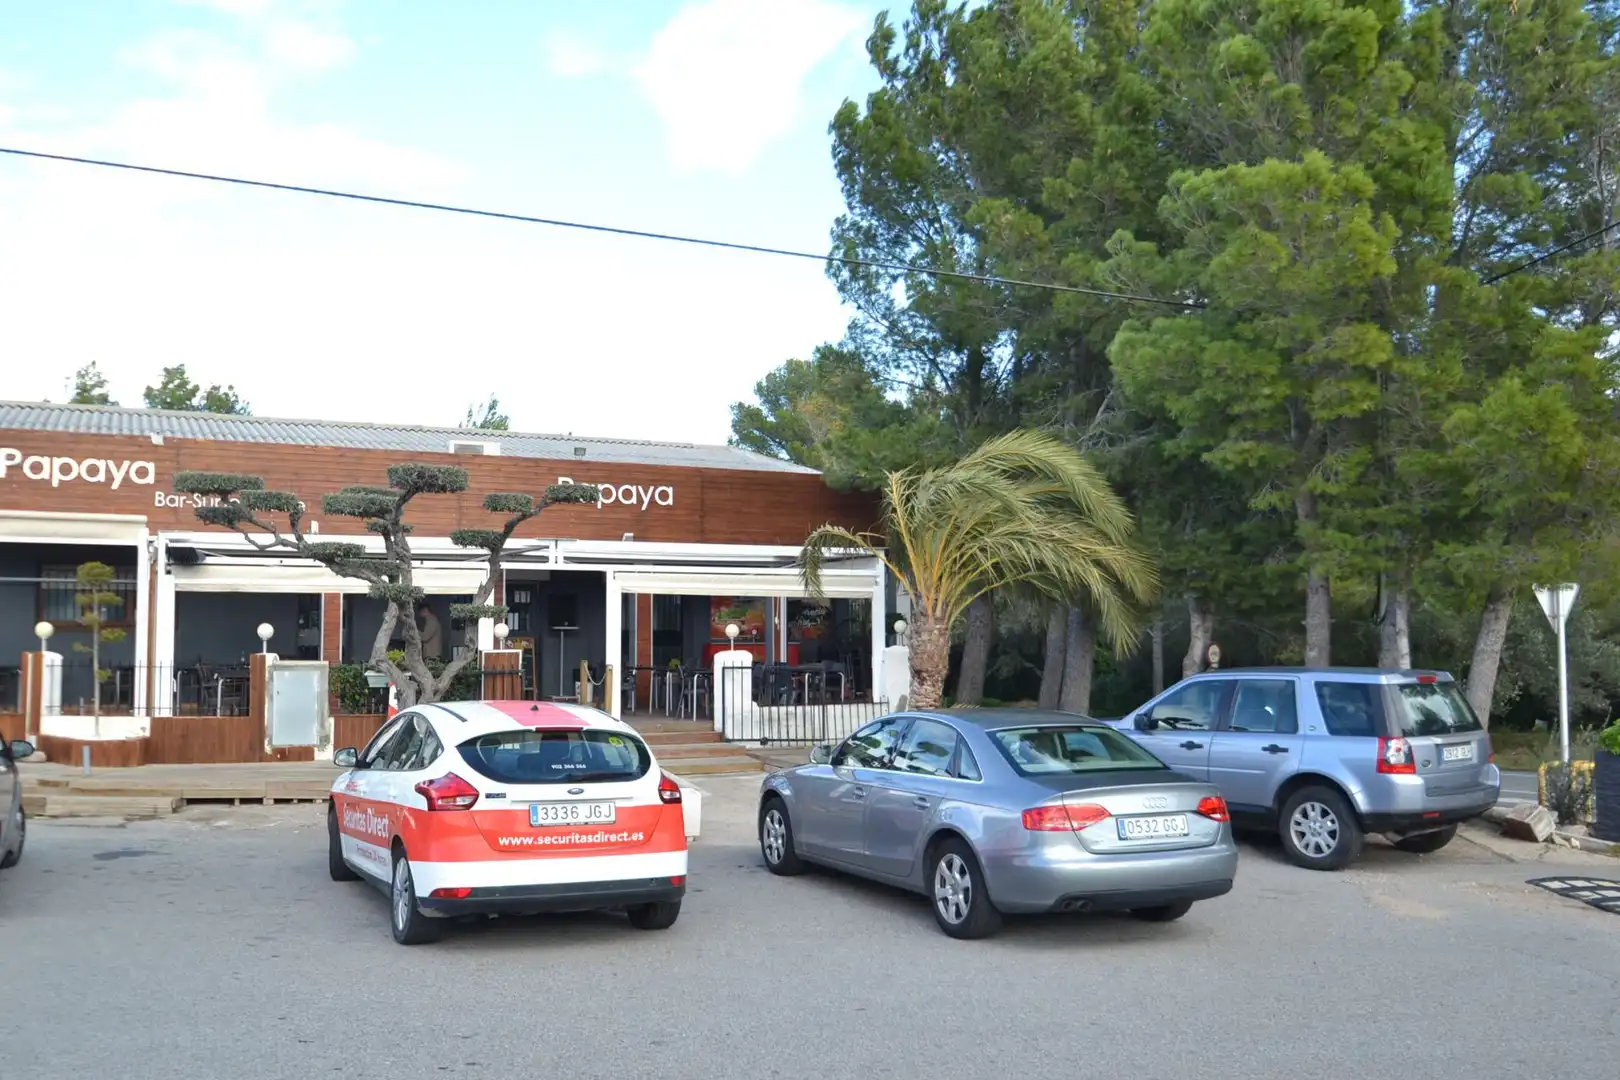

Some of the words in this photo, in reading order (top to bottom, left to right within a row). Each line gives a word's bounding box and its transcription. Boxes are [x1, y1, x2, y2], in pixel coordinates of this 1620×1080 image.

[0, 447, 156, 490] Papaya
[541, 805, 579, 821] 3336
[585, 803, 612, 819] JGJ
[366, 807, 389, 838] Direct
[1127, 818, 1160, 835] 0532
[1163, 817, 1187, 832] GGJ
[498, 830, 644, 846] www.securitasdirect.es
